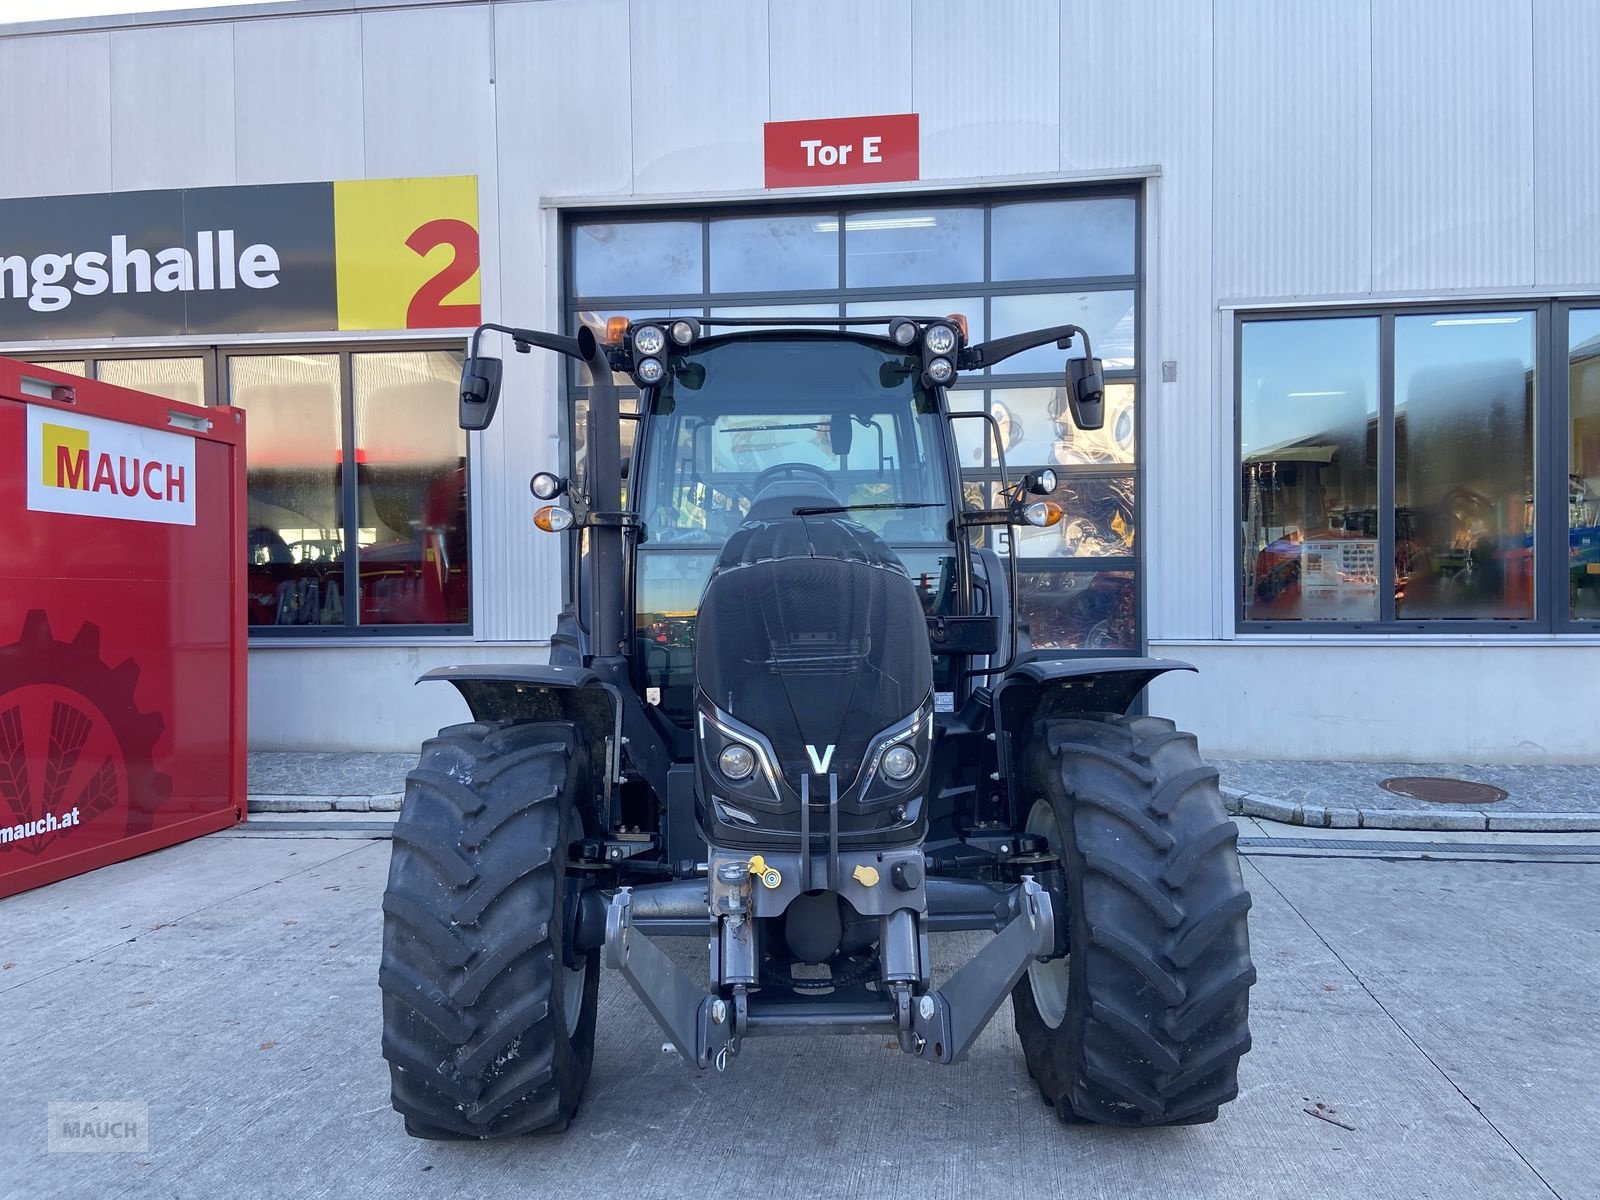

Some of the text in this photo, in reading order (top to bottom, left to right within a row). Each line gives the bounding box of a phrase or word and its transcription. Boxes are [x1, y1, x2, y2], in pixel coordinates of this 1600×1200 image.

[800, 136, 883, 167] Tor E
[0, 218, 482, 329] ngshalle 2
[56, 445, 185, 503] MAUCH
[805, 744, 837, 775] V
[0, 806, 80, 844] mauch.at
